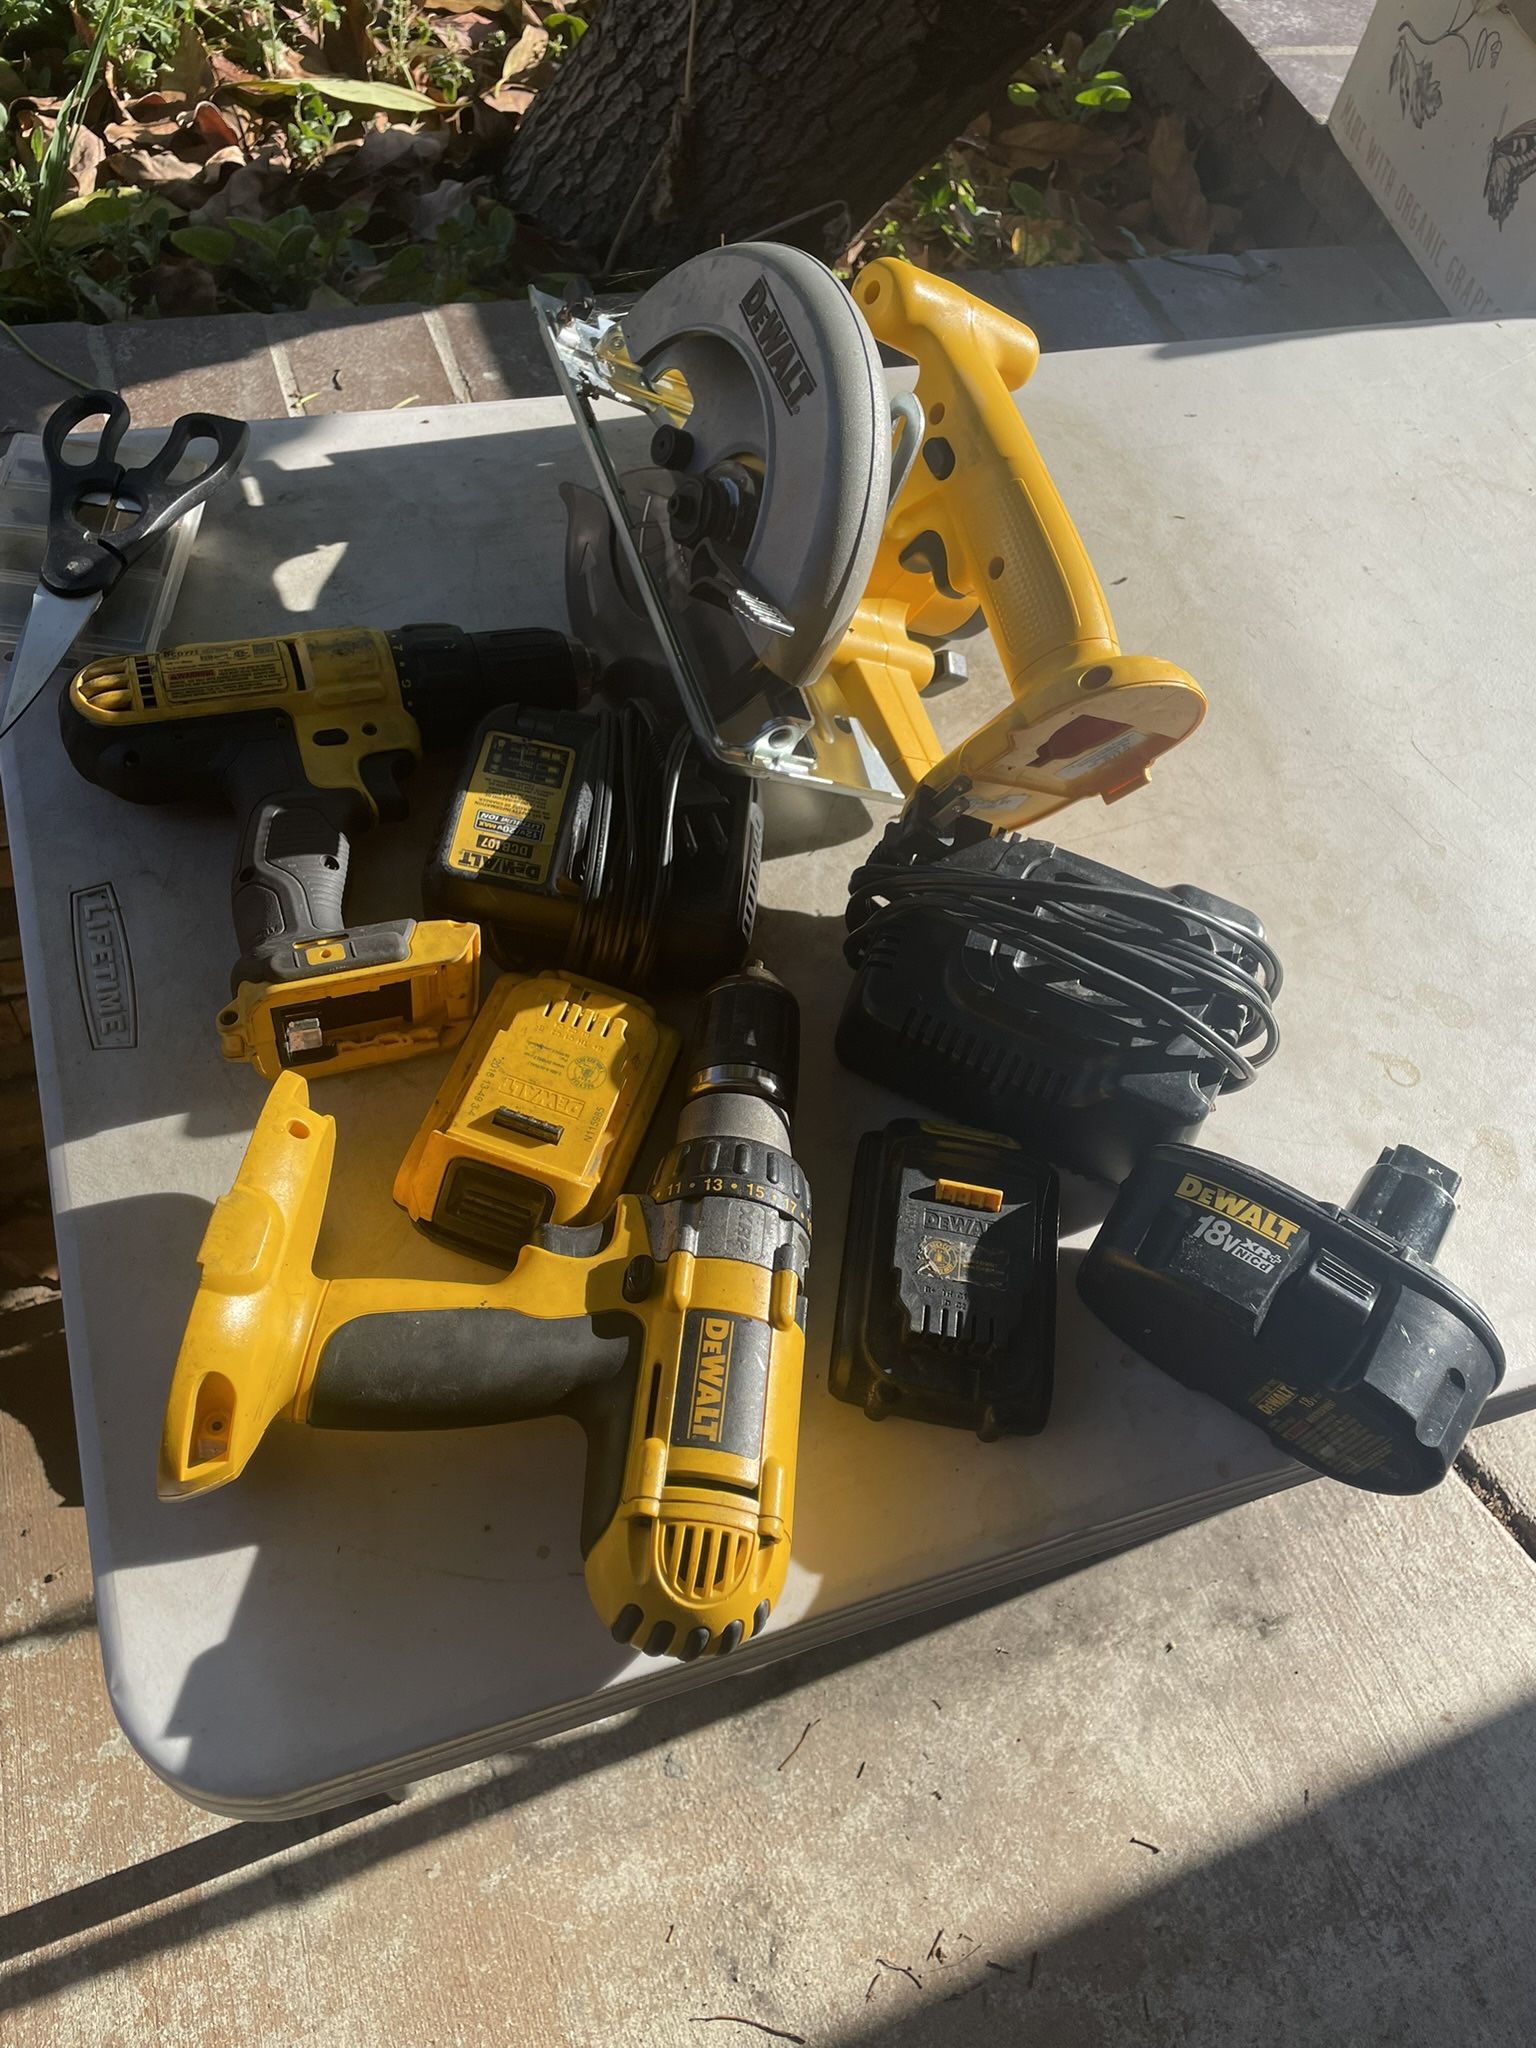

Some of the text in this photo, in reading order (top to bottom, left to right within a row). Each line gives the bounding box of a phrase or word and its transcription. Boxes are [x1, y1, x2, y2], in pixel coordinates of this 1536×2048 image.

[1341, 98, 1368, 151] MADE
[1366, 136, 1398, 192] WITH
[1394, 184, 1448, 268] ORGANIC
[480, 812, 500, 821] ION
[478, 821, 497, 830] MAX
[481, 836, 530, 855] DCB107
[83, 903, 125, 1036] LIFETIME
[667, 1182, 682, 1196] 11
[703, 1178, 723, 1191] 13
[746, 1183, 766, 1199] 15
[783, 1198, 798, 1213] 17
[1237, 1249, 1271, 1271] NiCd
